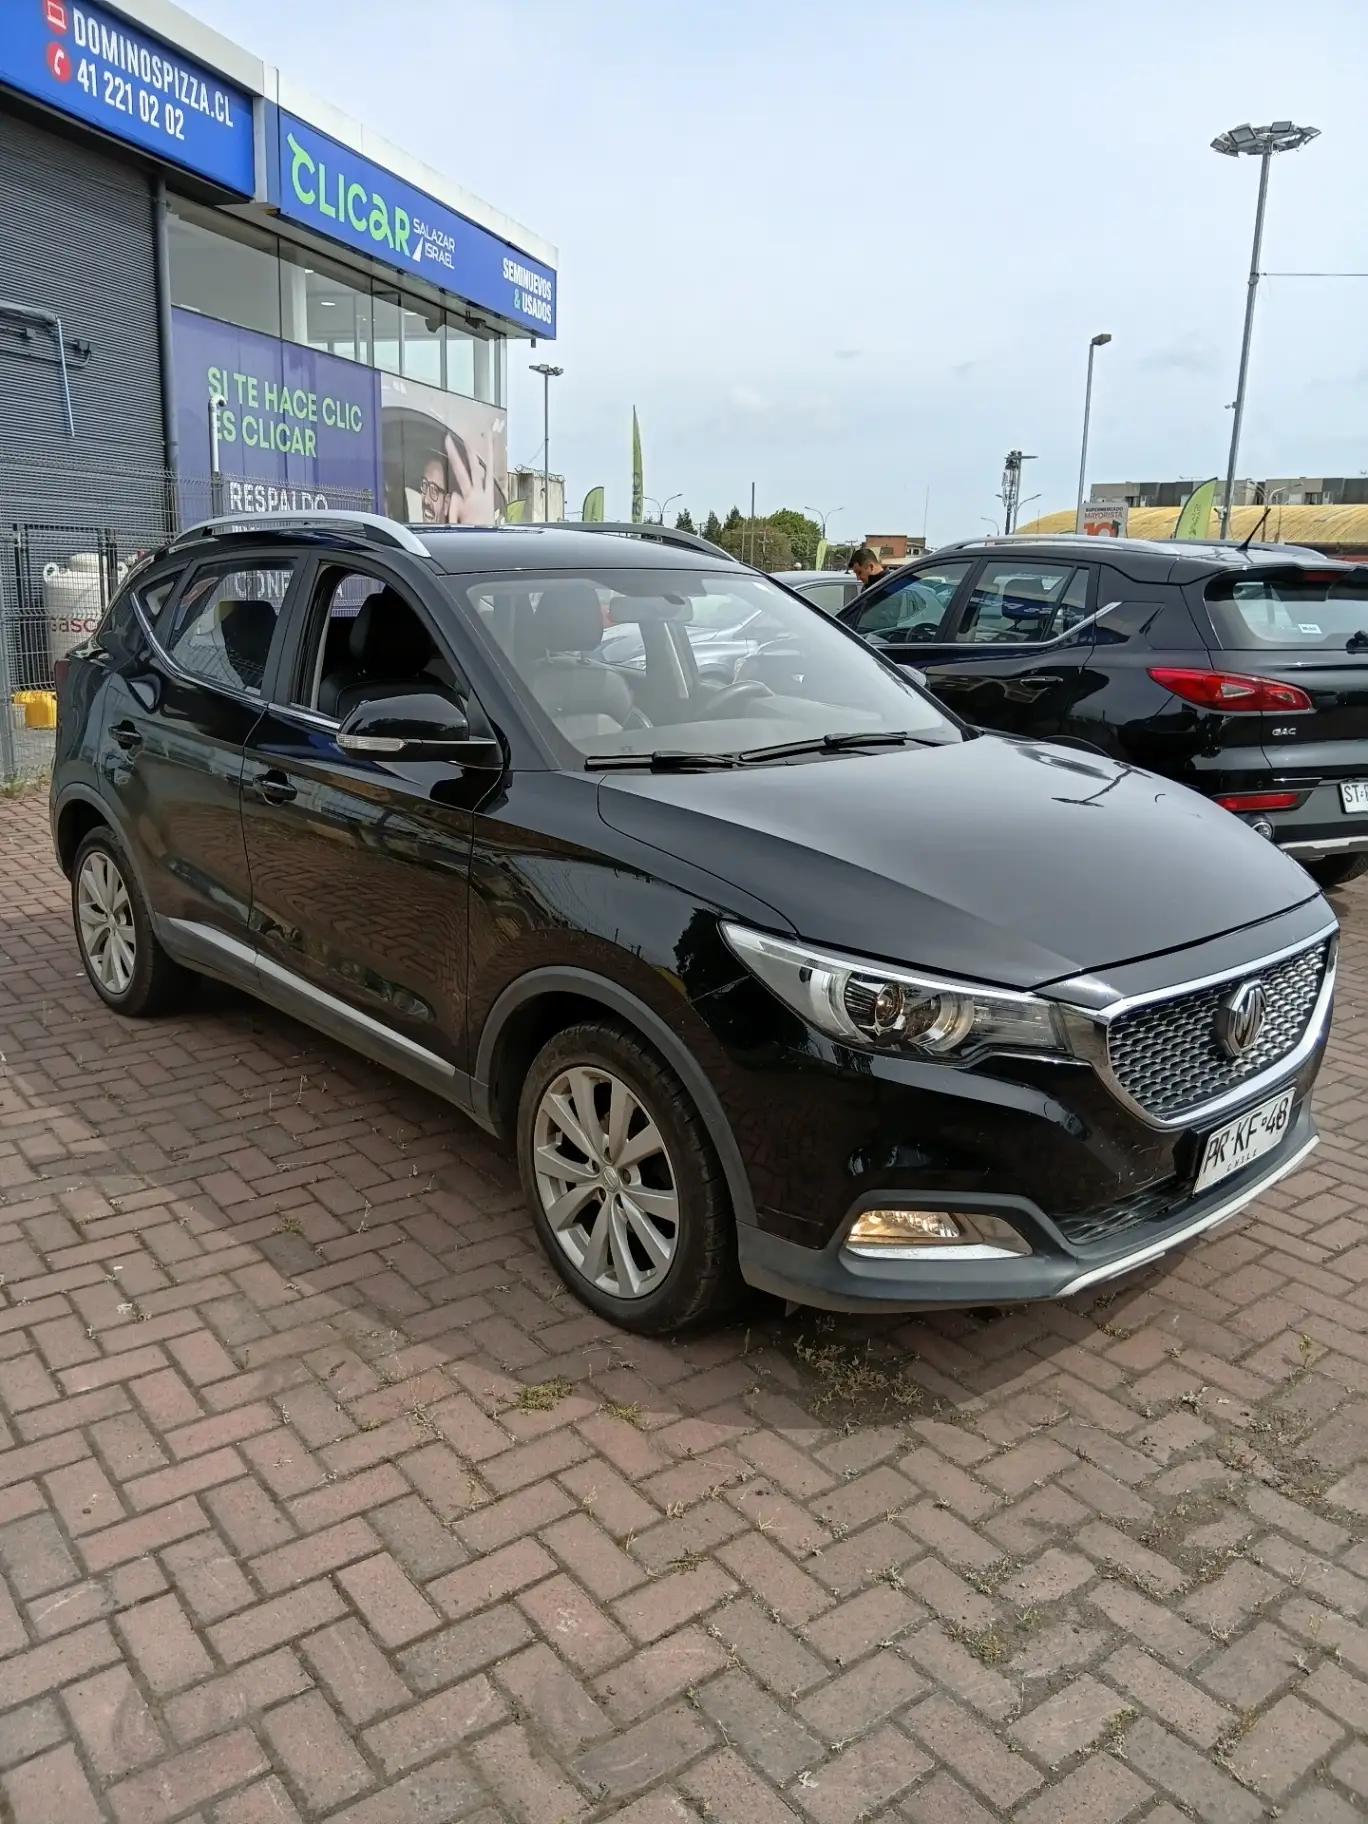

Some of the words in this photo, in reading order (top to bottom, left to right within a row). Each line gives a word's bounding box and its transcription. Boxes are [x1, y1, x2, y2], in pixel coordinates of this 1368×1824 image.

[73, 8, 233, 128] DOMINOSPIZZA.CL
[77, 58, 97, 97] 41
[104, 71, 133, 115] 221
[139, 90, 160, 128] 02
[165, 104, 185, 140] 02
[413, 218, 455, 253] SALAZAR
[424, 242, 455, 270] ISRAEL
[503, 257, 551, 301] SEMINUEVOS
[514, 288, 521, 310] &
[522, 292, 551, 324] USADOS
[208, 366, 228, 402] SI
[233, 372, 259, 408] TE
[265, 381, 317, 422] HACE
[322, 397, 362, 432] CLIC
[242, 416, 317, 458] CLICAR
[1272, 727, 1297, 736] GAC
